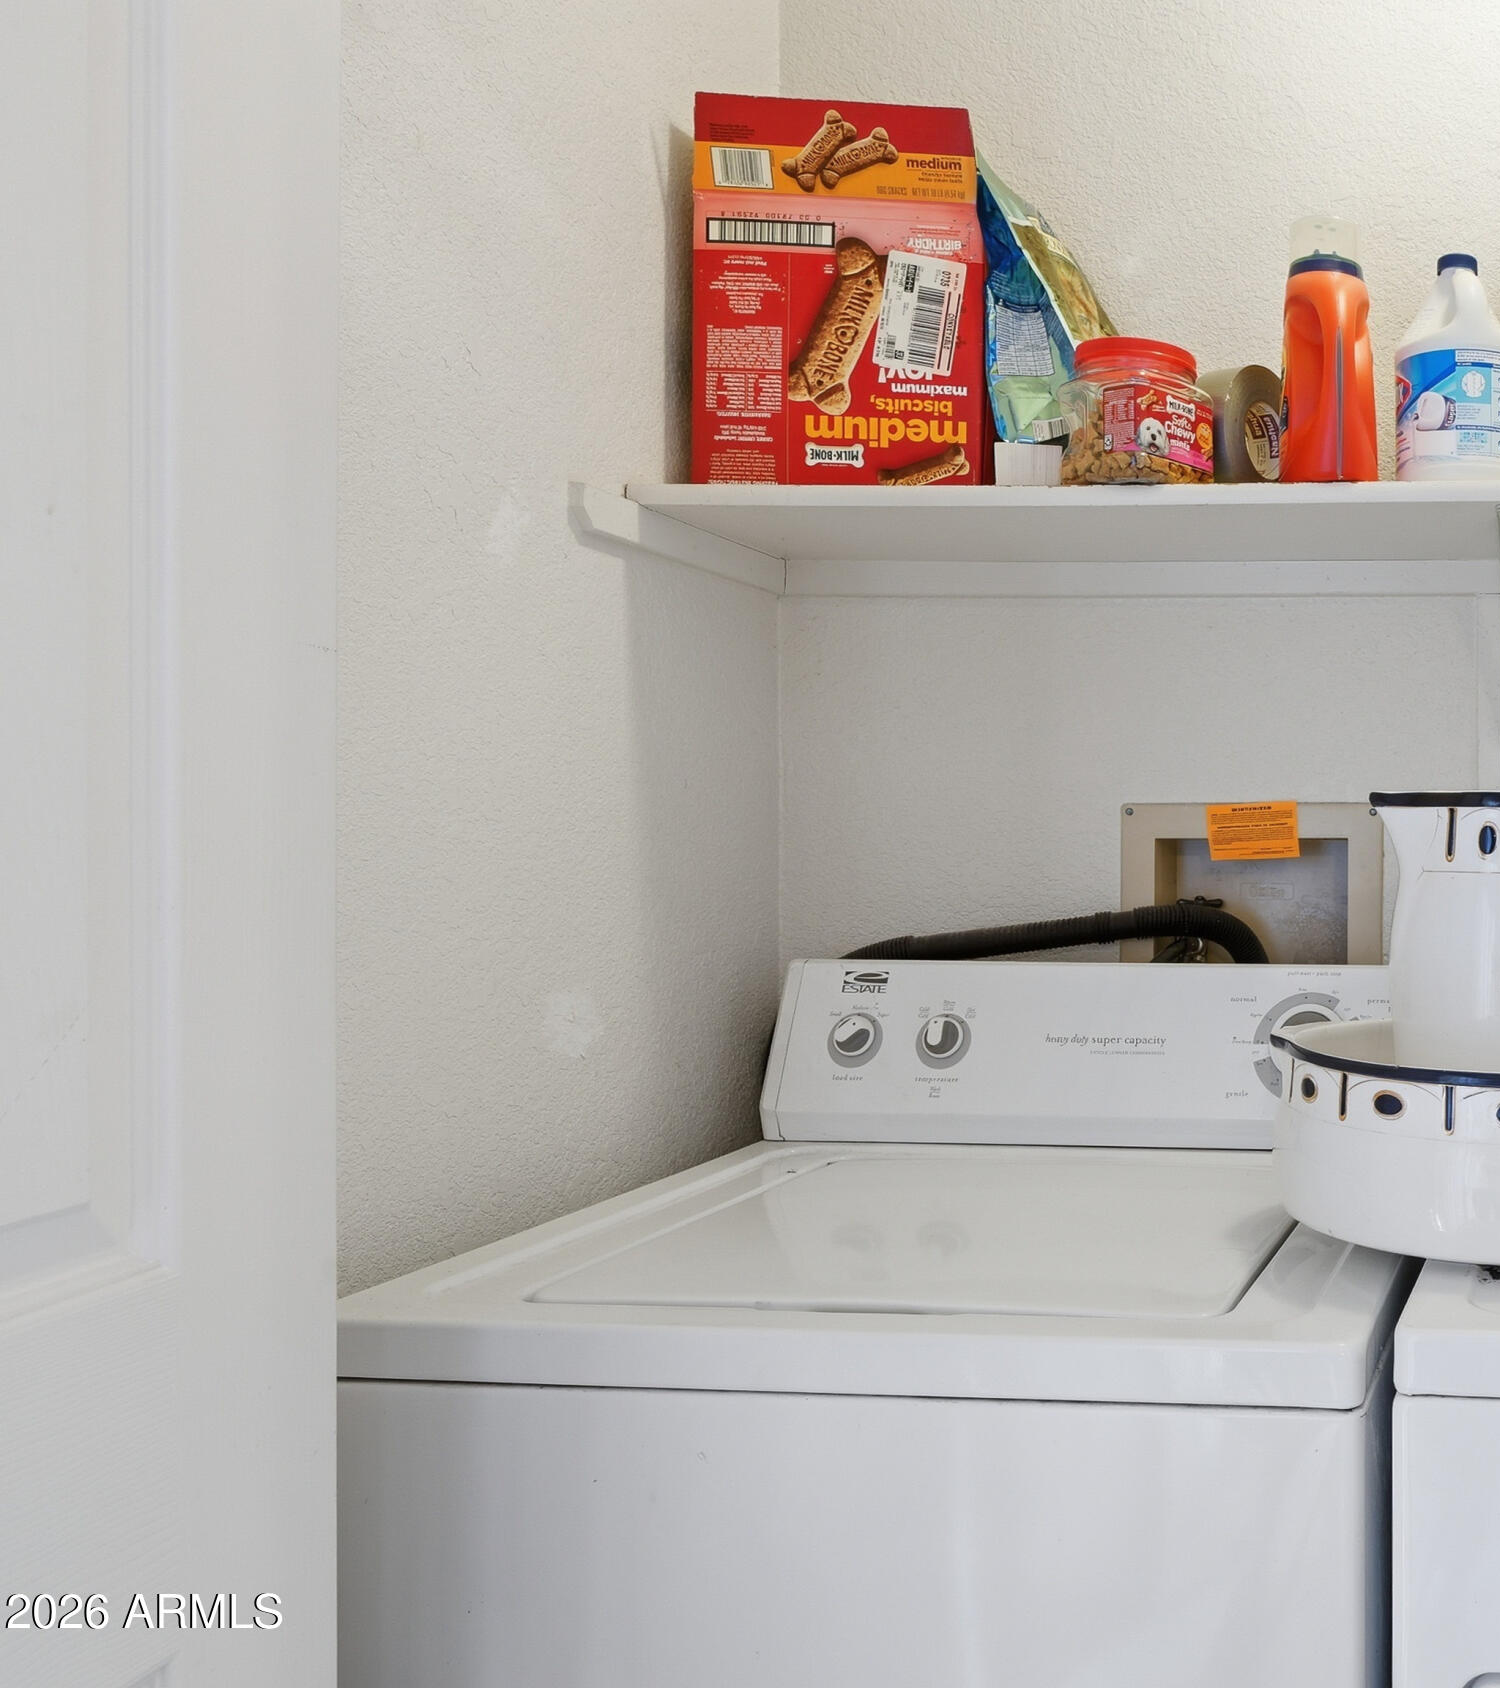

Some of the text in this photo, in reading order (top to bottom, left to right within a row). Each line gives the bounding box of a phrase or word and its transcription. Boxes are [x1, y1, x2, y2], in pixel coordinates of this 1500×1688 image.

[906, 157, 962, 171] medium
[907, 237, 962, 251] BIRTHDAY
[814, 287, 874, 383] MILK BONE
[891, 381, 967, 396] maximum
[870, 396, 953, 416] biscuits,
[805, 415, 967, 448] medium
[1165, 421, 1195, 443] Chewy
[841, 984, 887, 994] ESTATE
[1045, 1033, 1167, 1047] heavy duty super capacity
[832, 1073, 848, 1081] load
[915, 1076, 959, 1084] temperature
[1225, 1090, 1249, 1098] gentle
